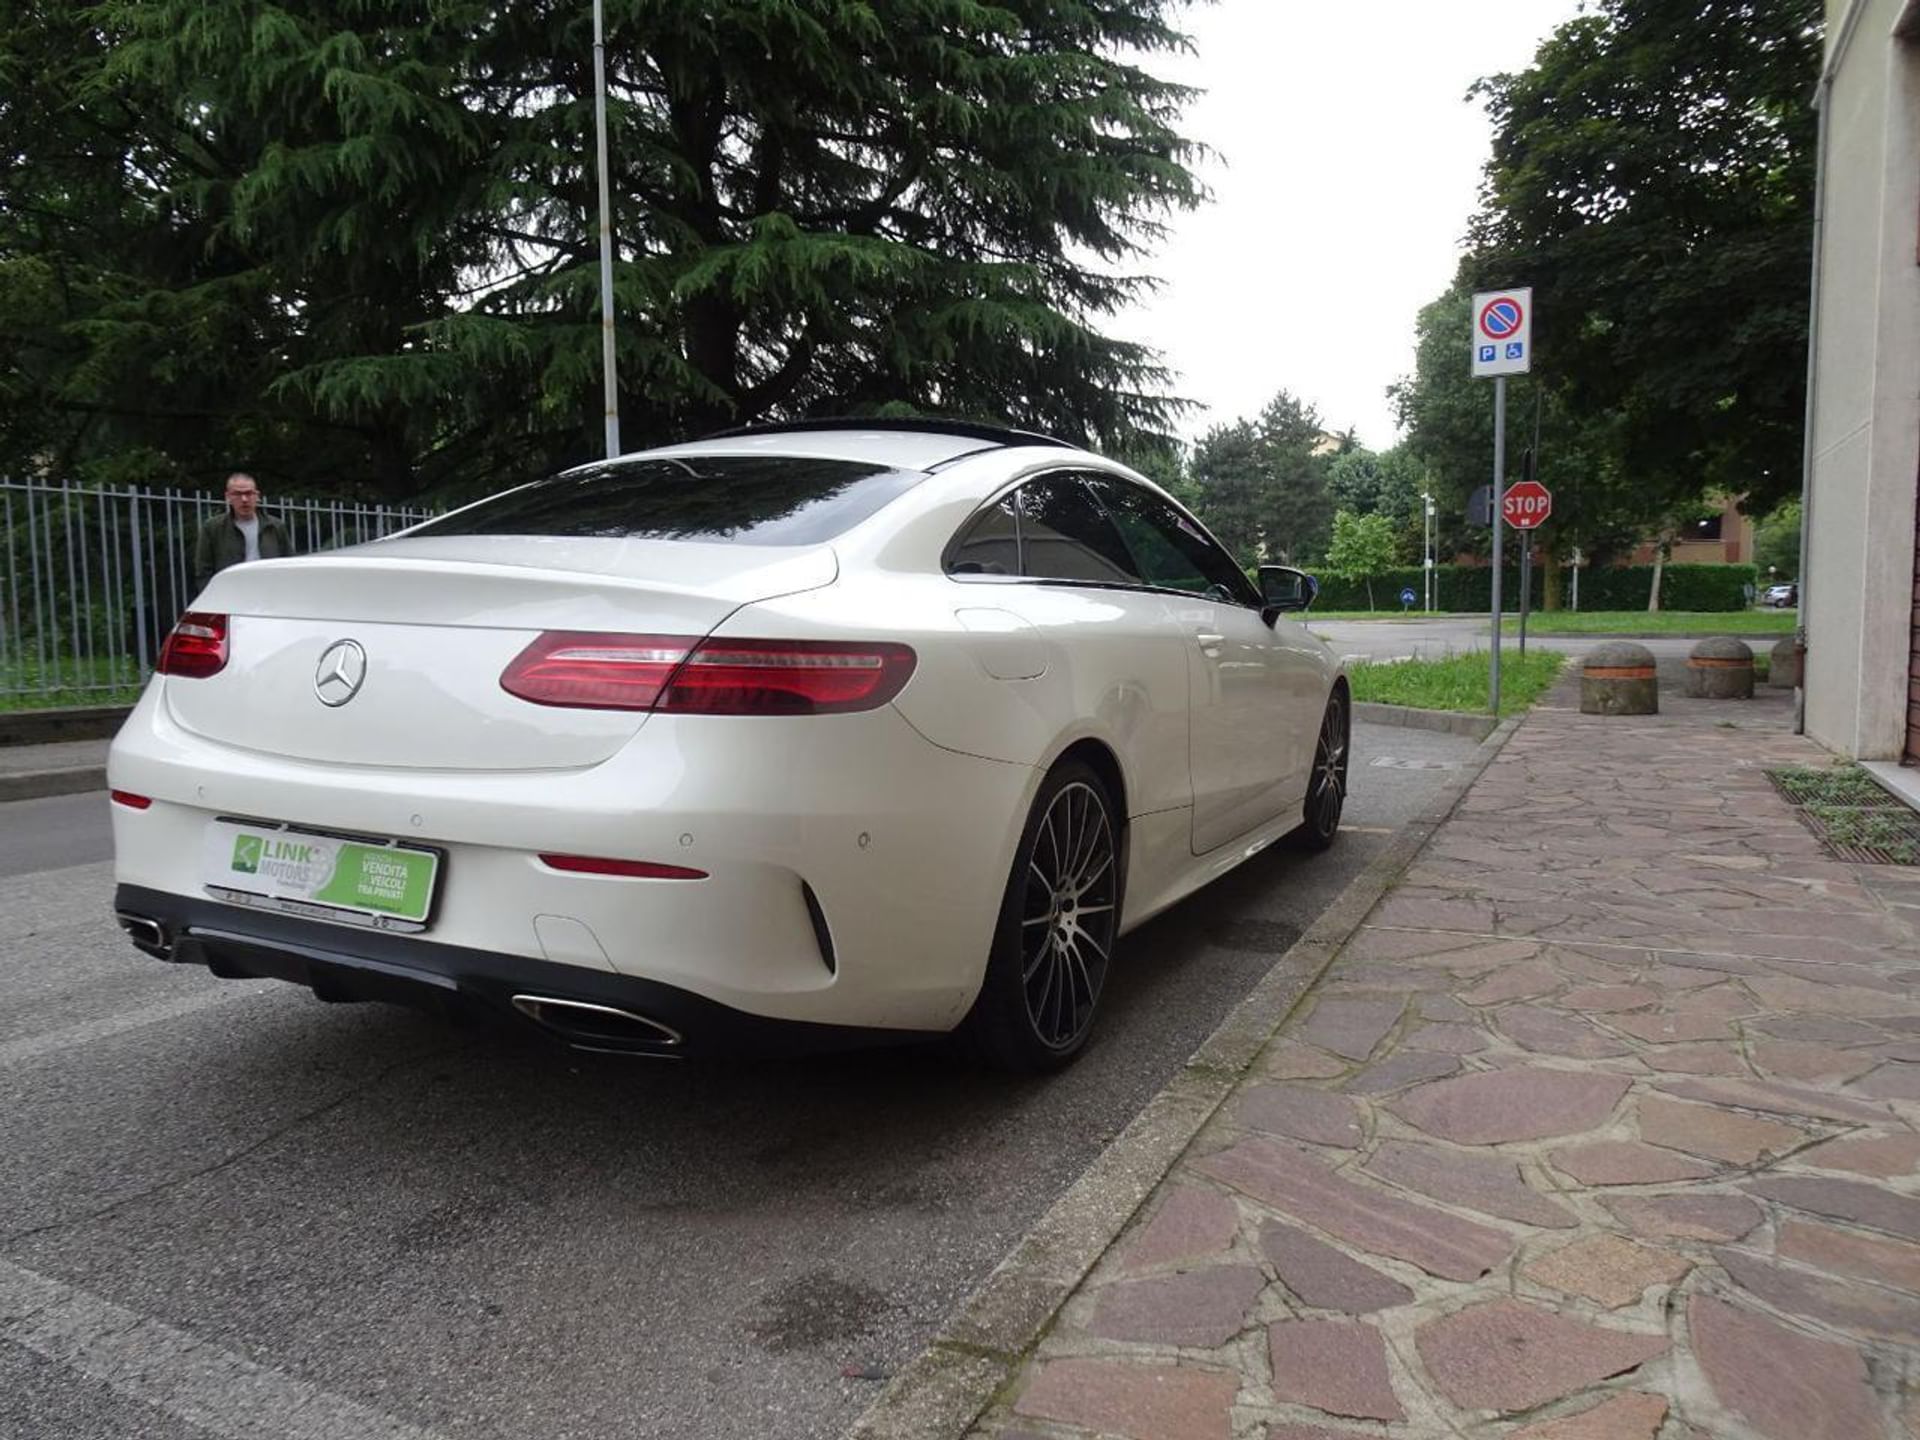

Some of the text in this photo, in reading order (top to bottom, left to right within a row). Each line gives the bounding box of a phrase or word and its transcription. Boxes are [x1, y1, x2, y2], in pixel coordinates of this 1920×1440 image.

[1482, 346, 1493, 360] P
[1504, 496, 1548, 514] STOP
[262, 840, 312, 863] LINK
[258, 859, 310, 882] MOTORS
[362, 862, 408, 879] VENDITA
[370, 875, 407, 891] VEICOLI
